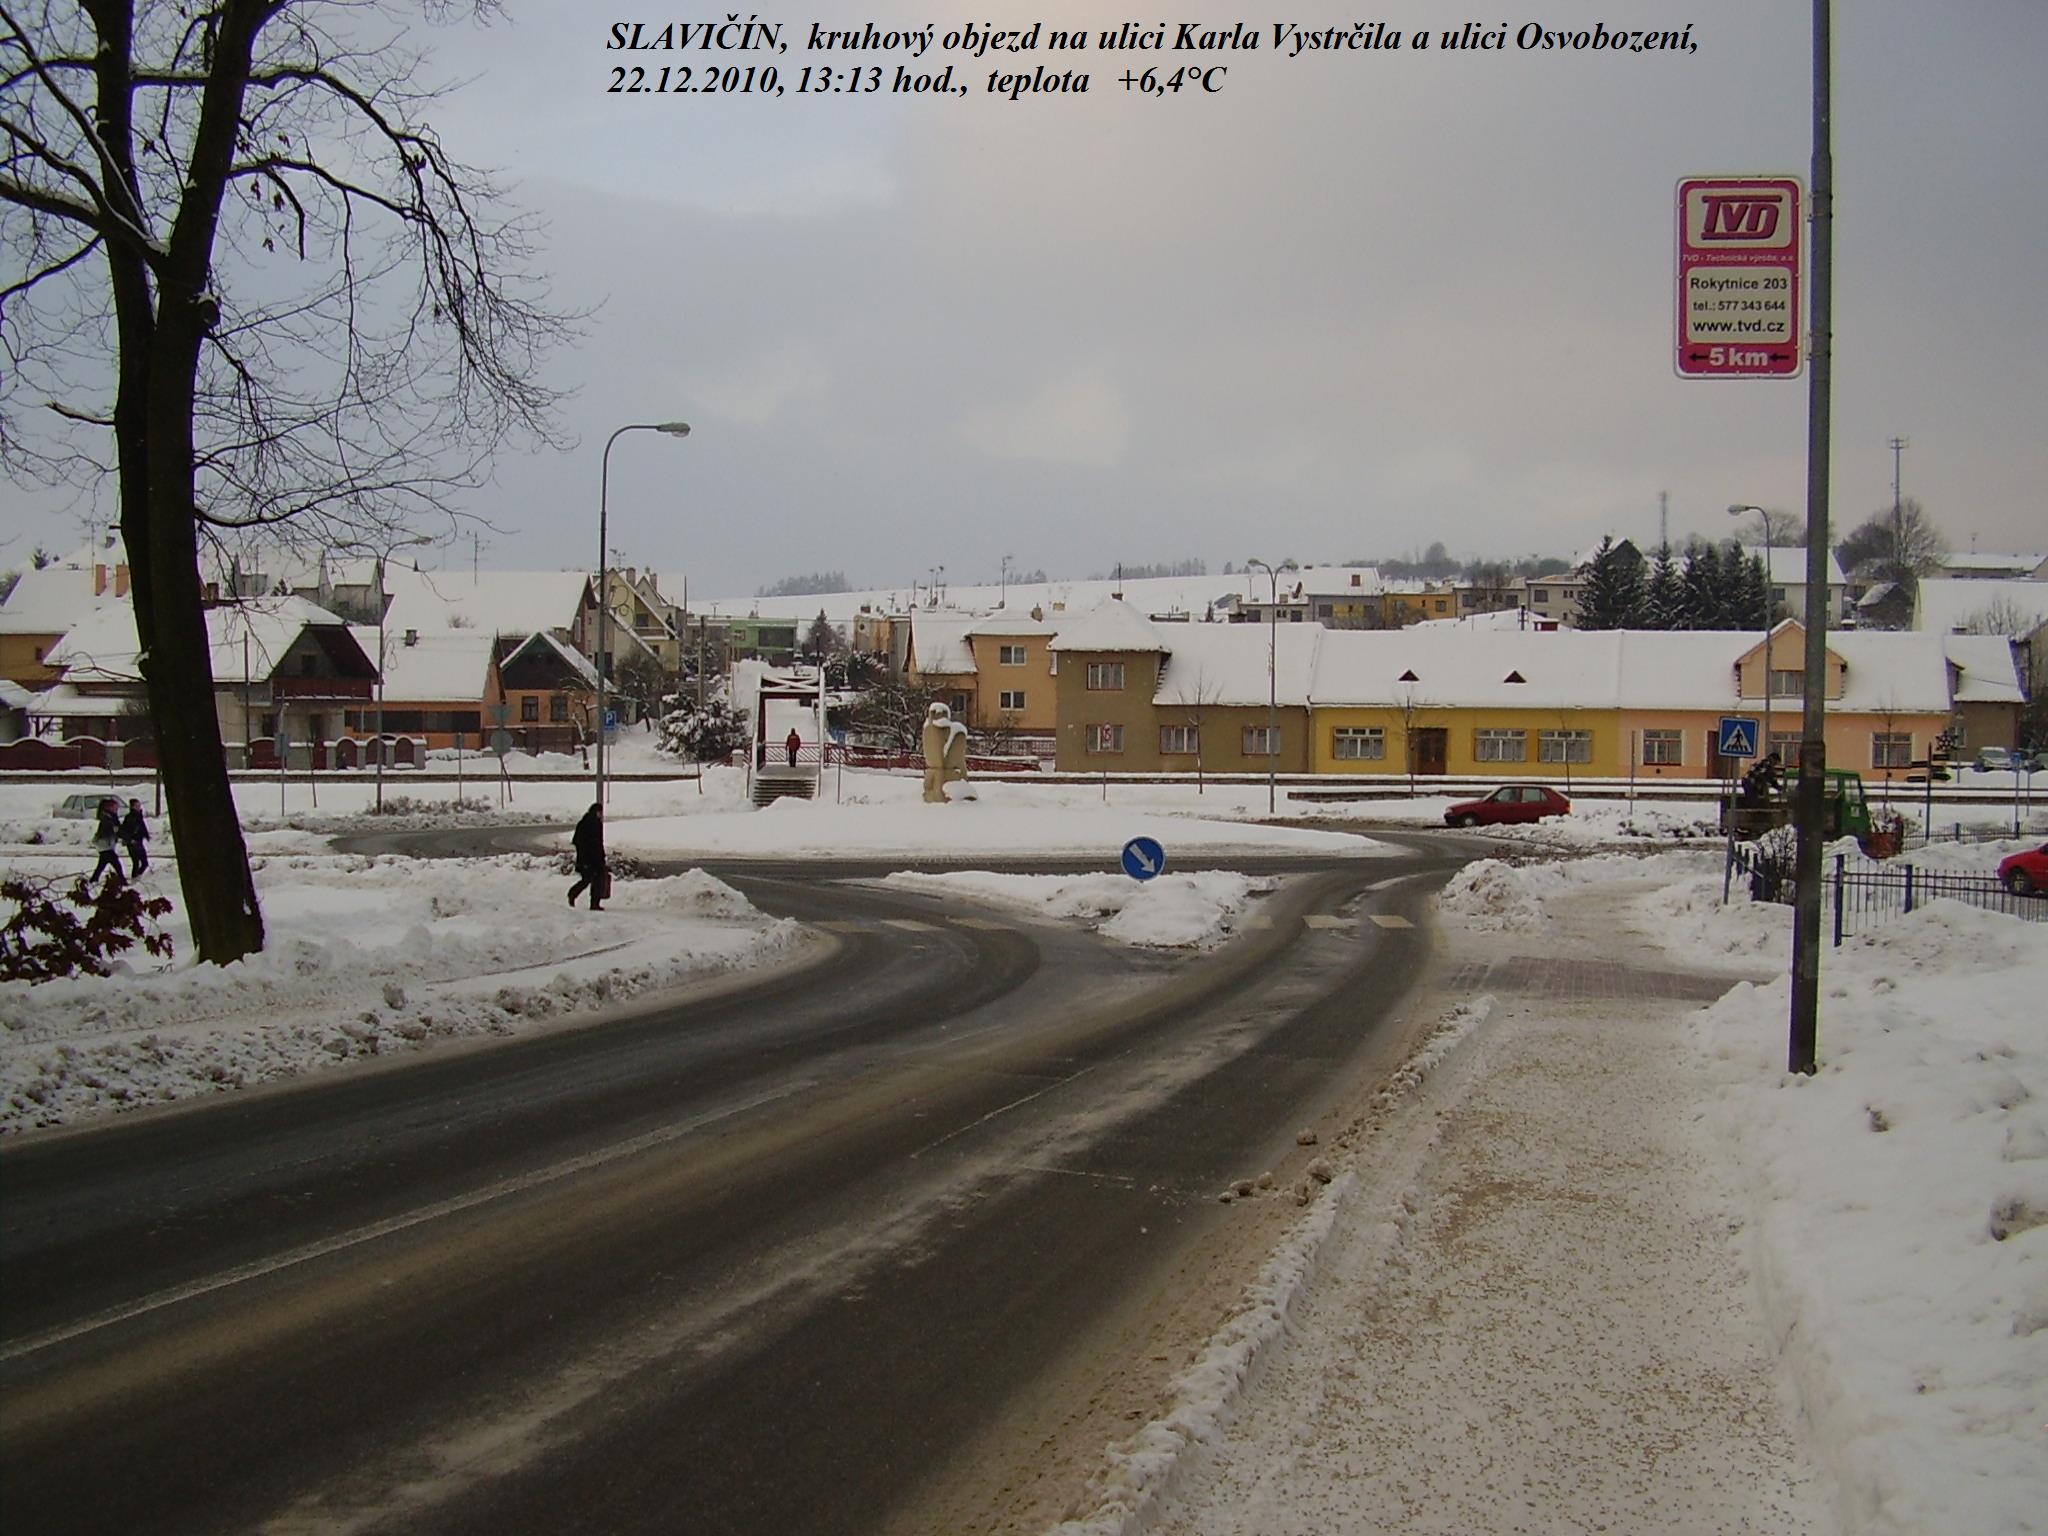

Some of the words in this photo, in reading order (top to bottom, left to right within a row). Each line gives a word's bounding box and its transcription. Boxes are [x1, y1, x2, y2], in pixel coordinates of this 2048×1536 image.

[1701, 195, 1782, 240] TVD
[1690, 277, 1759, 292] Rokytnice
[1763, 278, 1788, 289] 203
[1693, 300, 1716, 311] tel.:
[1718, 301, 1739, 311] 577
[1741, 301, 1762, 311] 343
[1764, 301, 1785, 311] 644
[1693, 319, 1785, 333] www.tvd.cz
[1709, 347, 1725, 366] 5
[1728, 348, 1768, 366] km
